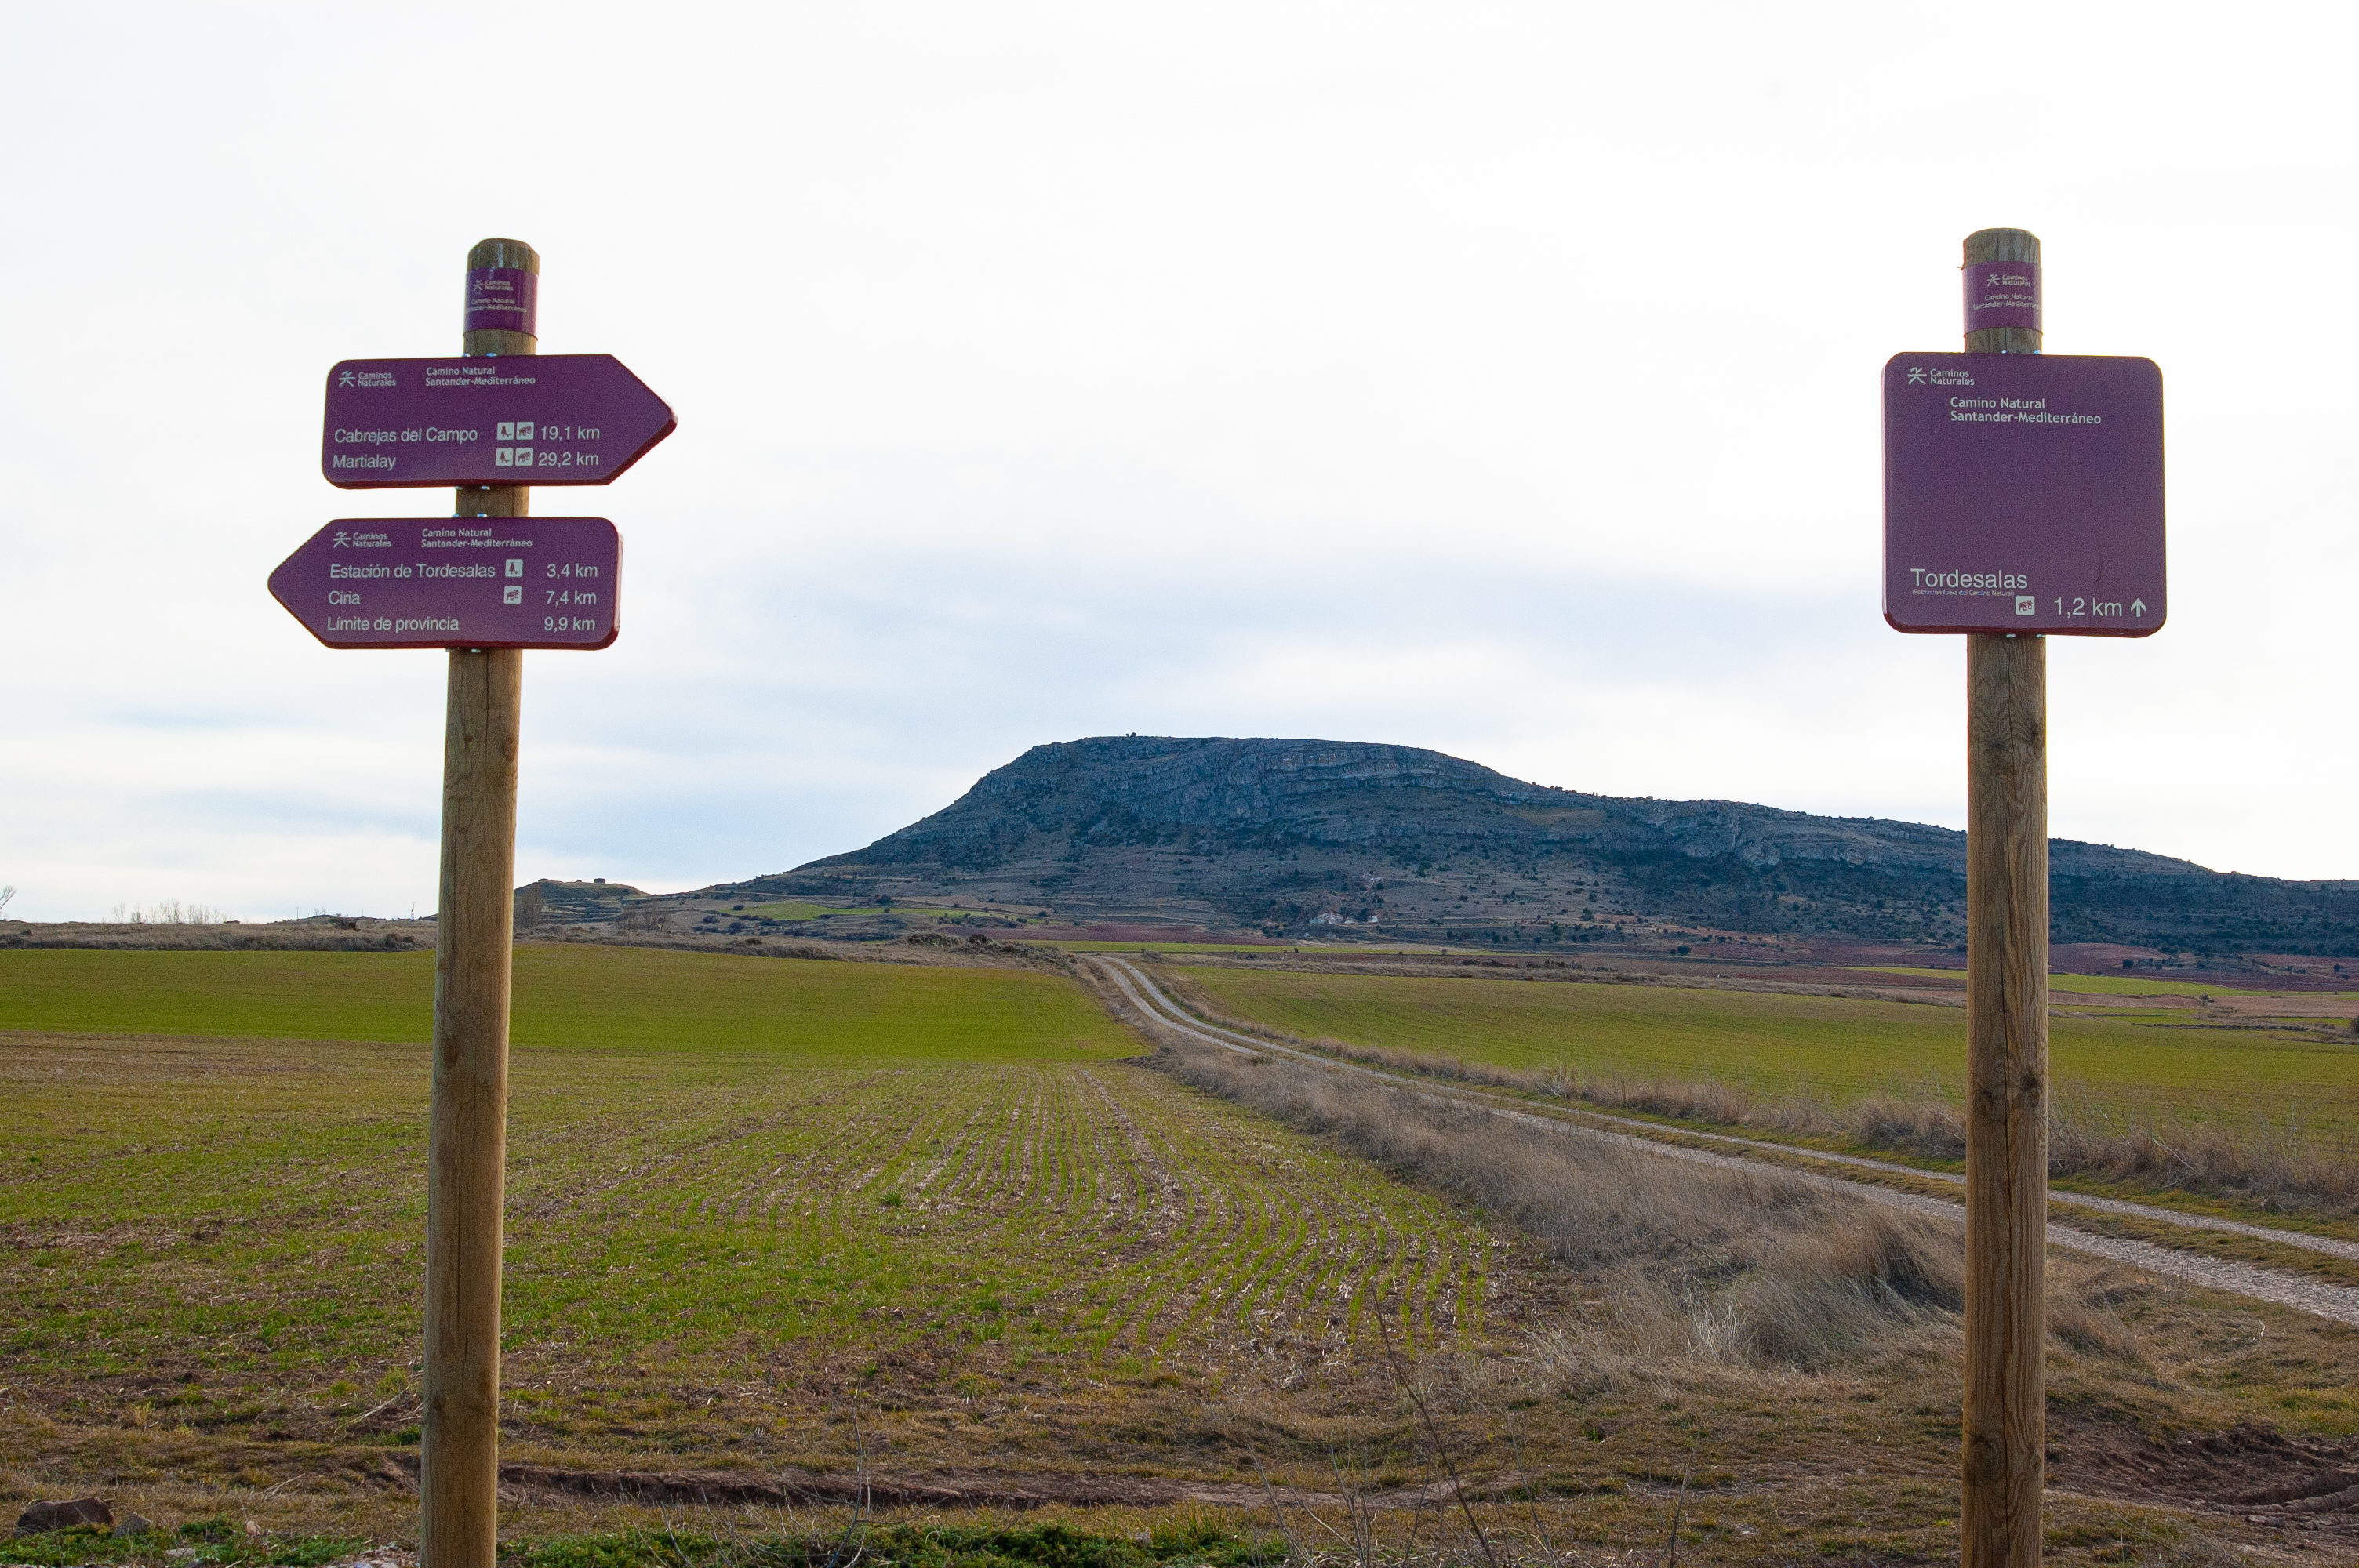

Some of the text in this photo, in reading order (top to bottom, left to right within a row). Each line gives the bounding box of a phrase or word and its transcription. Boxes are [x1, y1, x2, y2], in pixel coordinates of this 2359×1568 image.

[425, 366, 496, 376] Camino Natural
[1929, 368, 1969, 378] Caminos
[358, 378, 397, 387] Naturales
[425, 376, 536, 387] Santander-Mediterráneo
[1929, 376, 1975, 387] Naturales
[1950, 396, 2045, 409] Camino Natural
[1950, 410, 2102, 424] Santander-Mediterráneo
[334, 426, 478, 445] Cabrejas del Campo
[540, 425, 600, 441] 19,1 km
[333, 454, 396, 470] Martialay
[538, 452, 599, 467] 29,2 km
[352, 532, 387, 540] Caminos
[421, 528, 492, 538] Camino Natural
[353, 539, 391, 548] Naturales
[421, 536, 533, 548] Santander-Mediterráneo
[329, 563, 496, 579] Estación de Tordesalas
[546, 563, 598, 579] 3,4 km
[1910, 568, 2028, 588] Tordesalas
[328, 590, 360, 605] Ciria
[545, 590, 597, 606] 7,4 km
[2053, 597, 2123, 619] 1,2 km
[327, 615, 460, 634] Límite de provincia
[543, 615, 595, 633] 9,9 km
